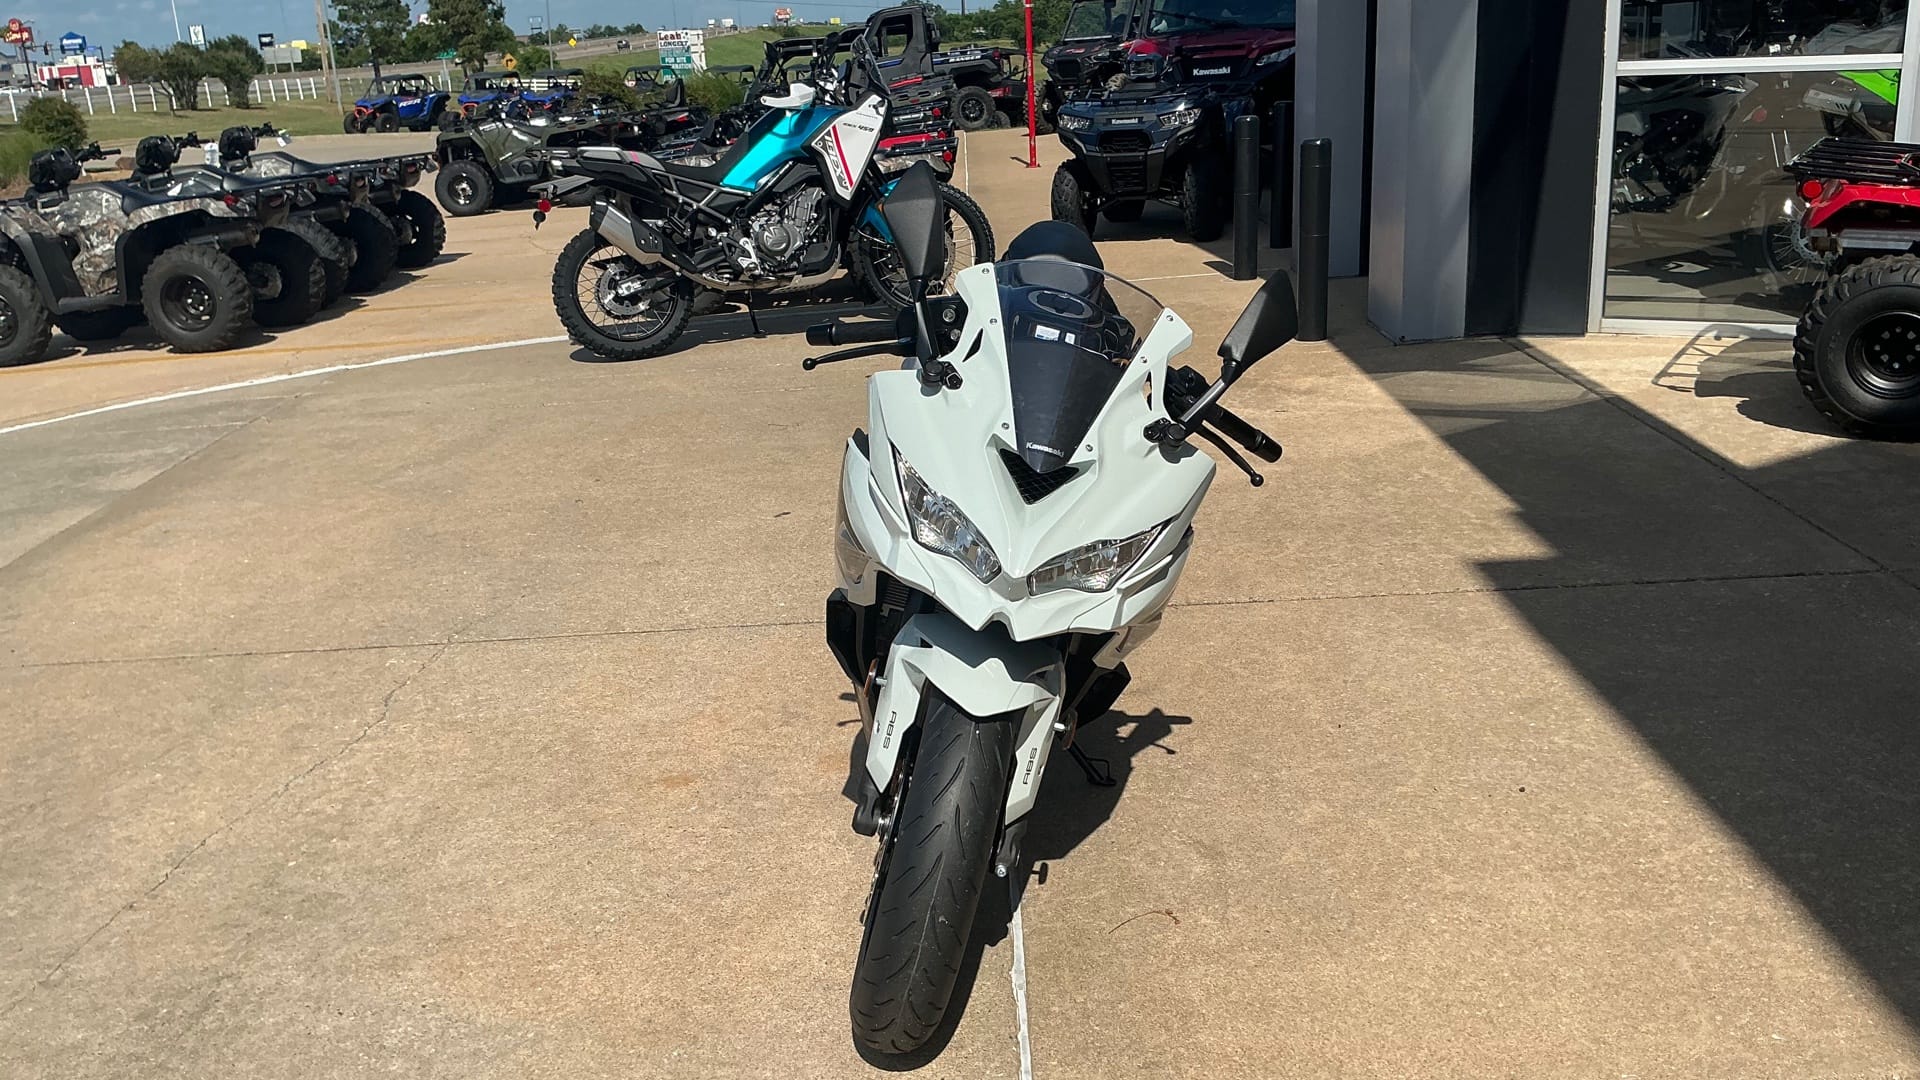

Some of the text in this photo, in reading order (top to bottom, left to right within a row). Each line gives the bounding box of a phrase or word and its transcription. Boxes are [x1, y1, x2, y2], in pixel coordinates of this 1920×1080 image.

[1192, 65, 1231, 76] Kawasaki
[1025, 441, 1065, 458] Kawasaki
[882, 710, 898, 750] ABS
[1022, 747, 1038, 785] ABS
